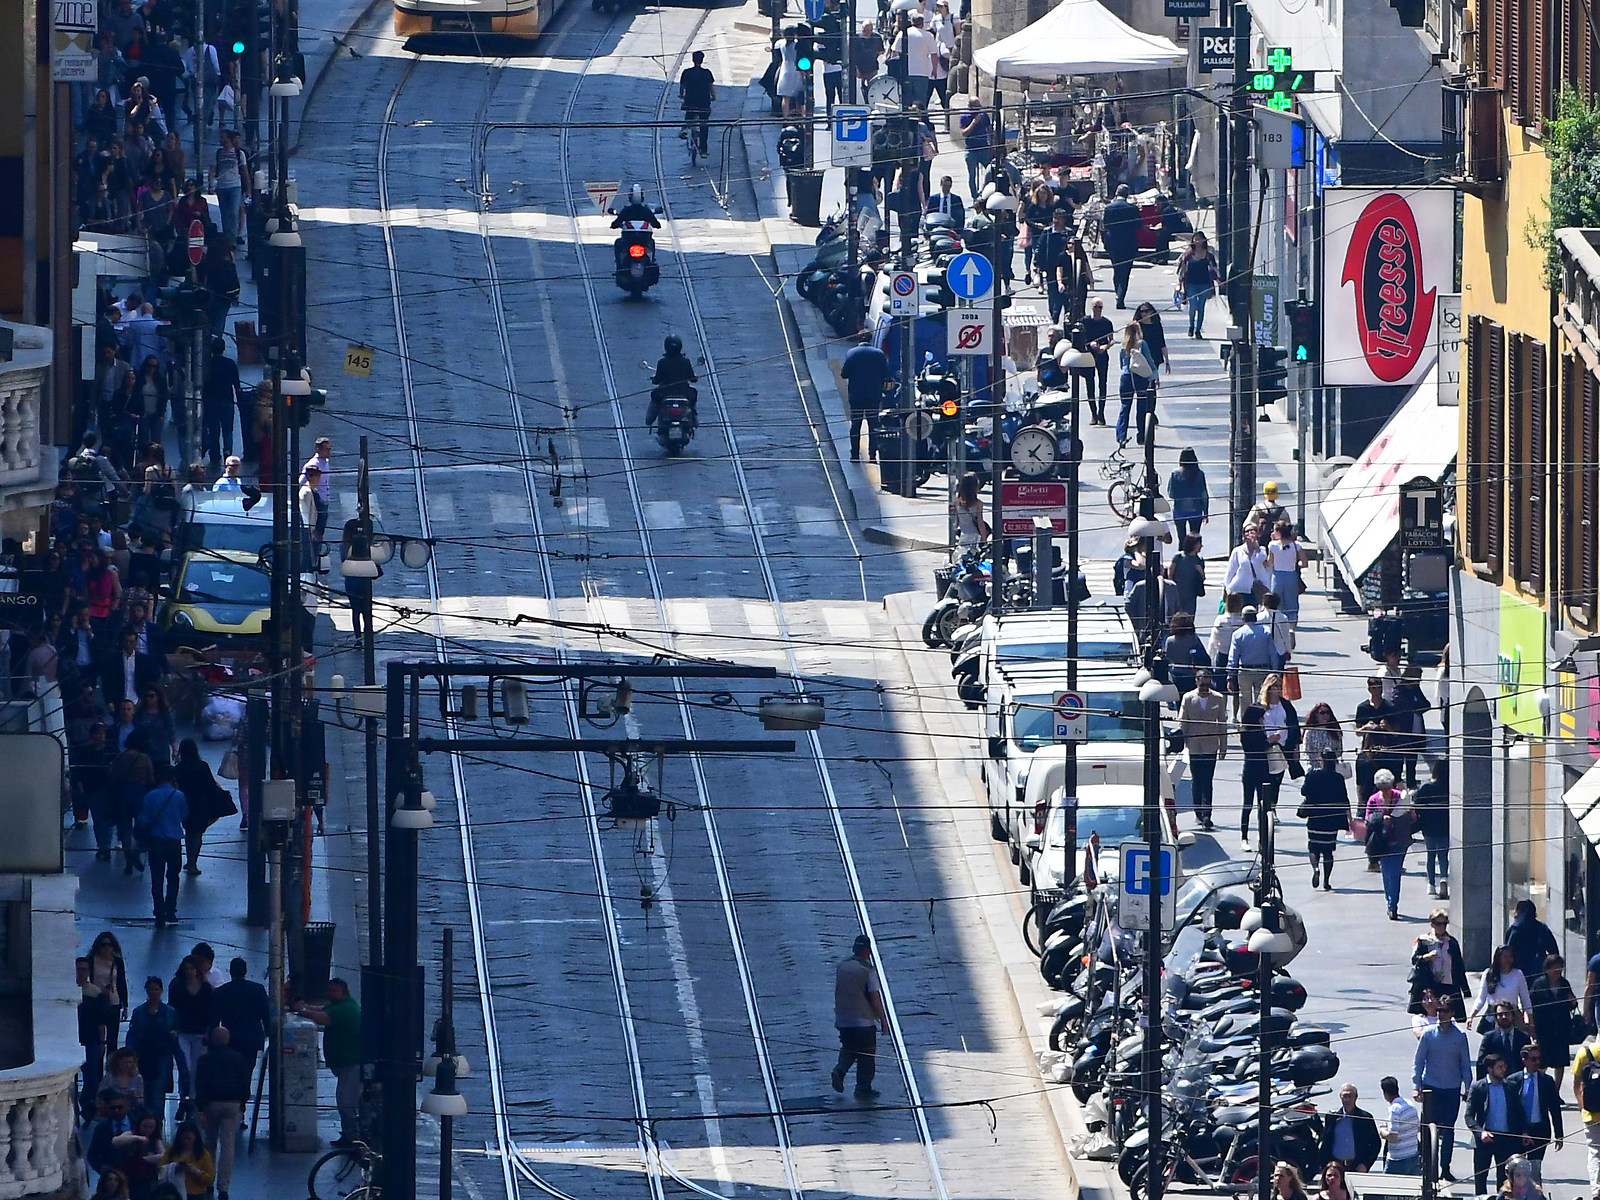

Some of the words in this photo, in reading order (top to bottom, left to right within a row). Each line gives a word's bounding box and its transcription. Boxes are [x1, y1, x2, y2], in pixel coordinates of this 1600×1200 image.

[842, 113, 862, 138] P
[1263, 133, 1283, 143] 183
[1367, 224, 1412, 357] Treesse
[347, 354, 370, 369] 145
[1406, 490, 1436, 527] T
[1058, 725, 1066, 735] P
